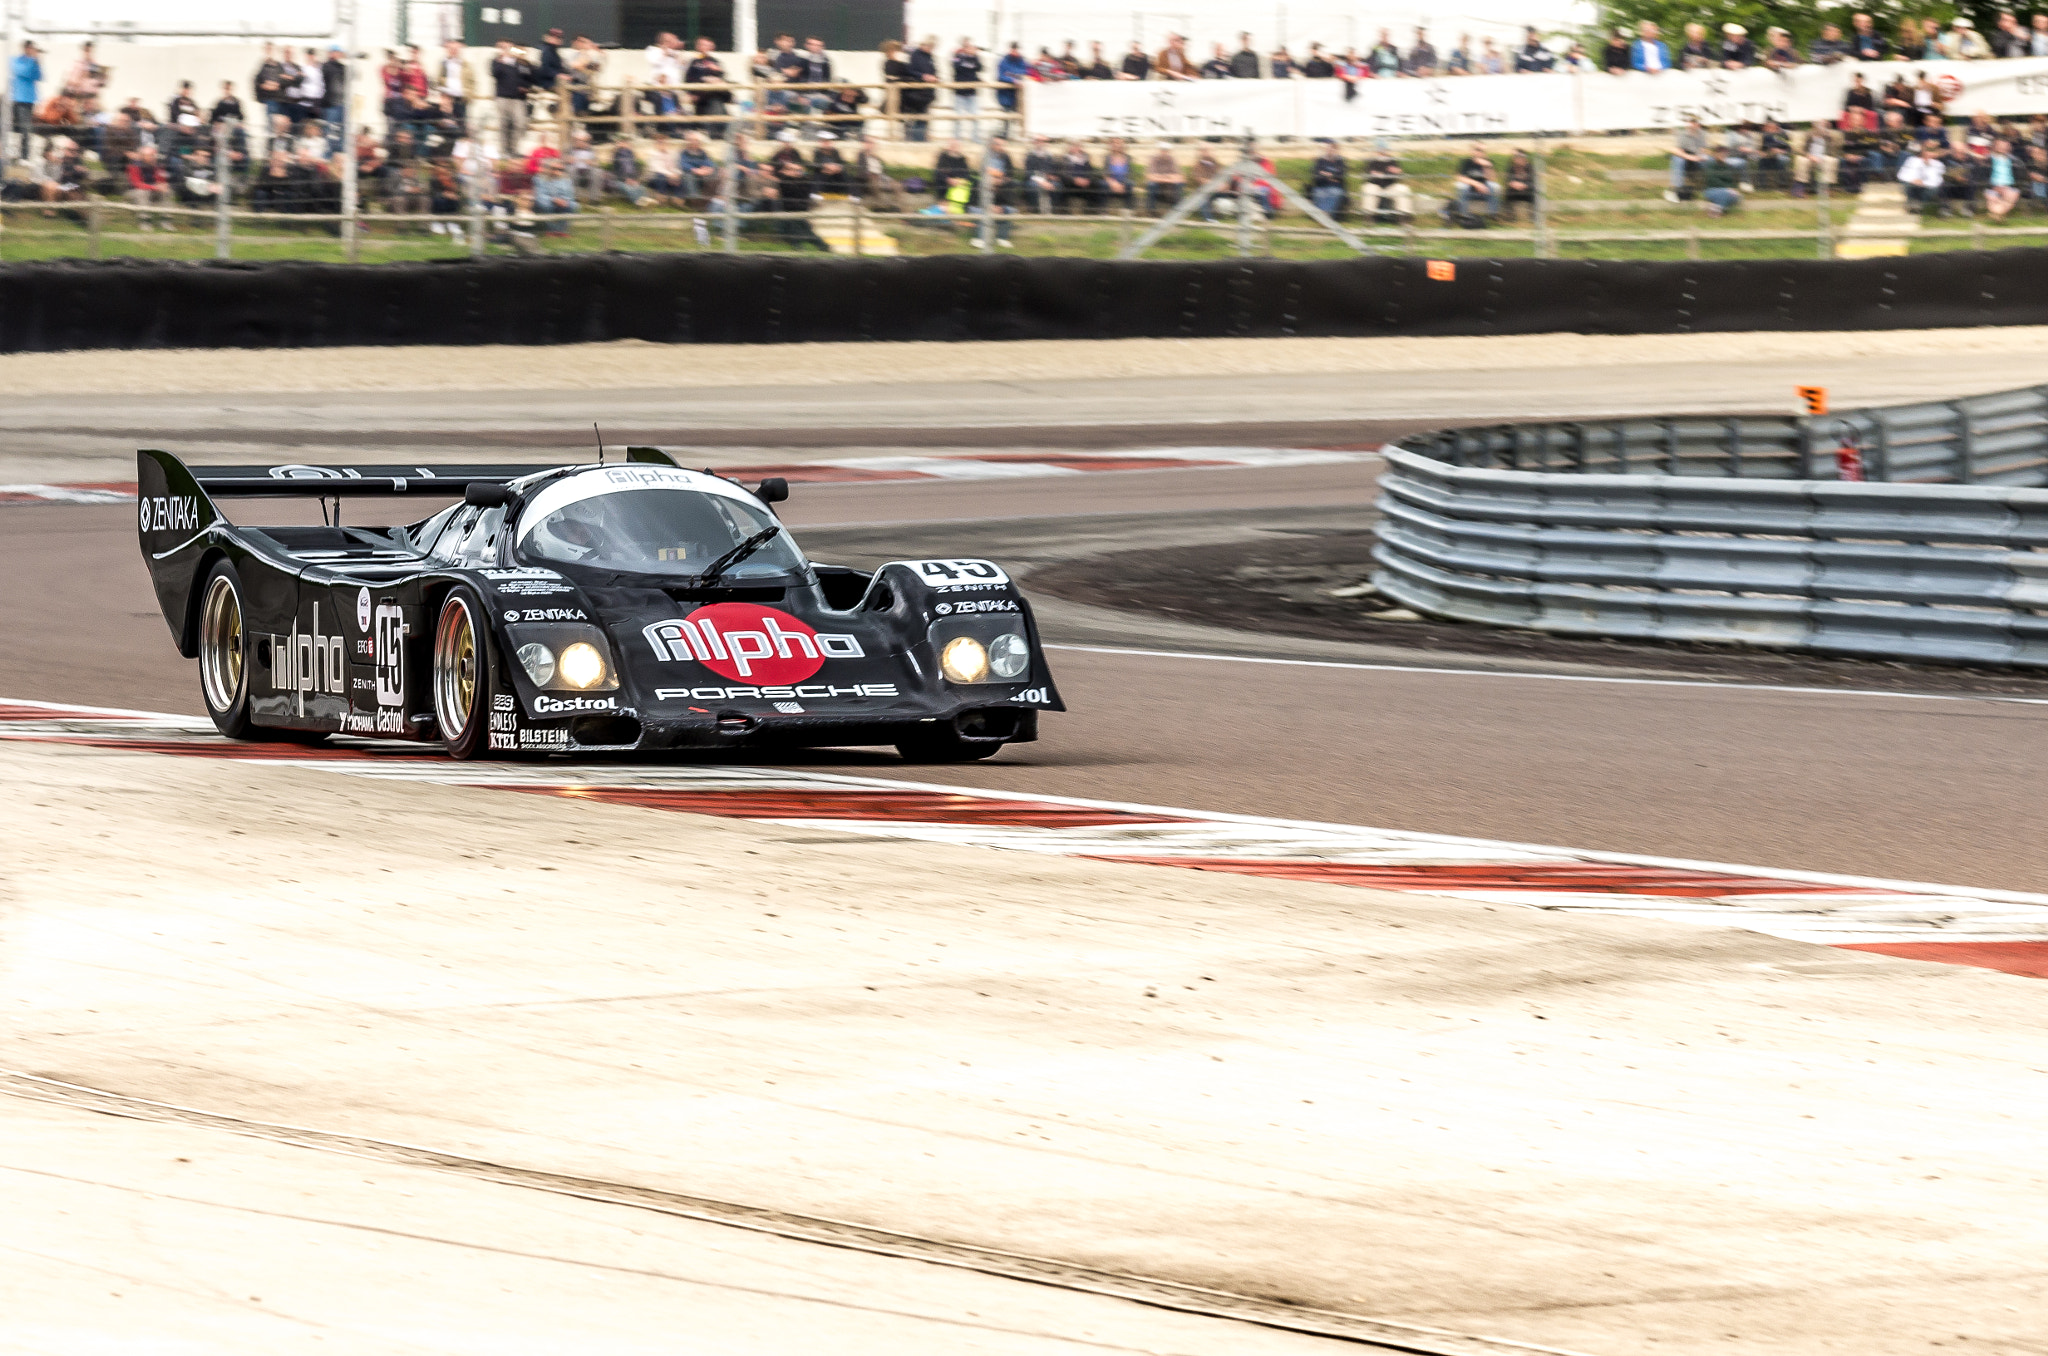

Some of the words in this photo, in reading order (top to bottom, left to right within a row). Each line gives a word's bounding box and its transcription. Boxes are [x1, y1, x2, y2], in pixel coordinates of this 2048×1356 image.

[1650, 101, 1788, 122] ZENITH
[1097, 114, 1233, 133] ZENITH
[1372, 112, 1509, 131] ZENITH
[605, 470, 693, 485] Alpha
[152, 496, 199, 531] ZENITAKA
[921, 561, 998, 579] 45
[935, 583, 1007, 593] ZENITH
[521, 608, 588, 620] ZENITAKA
[953, 600, 1019, 613] ZENITAKA
[378, 616, 401, 694] 45
[642, 617, 866, 677] Alpha
[353, 678, 376, 691] ZENITH
[654, 684, 899, 700] PORSCHE
[534, 696, 619, 713] Castrol
[347, 713, 375, 732] YOKOHAMA
[377, 706, 404, 733] Castrol
[489, 712, 517, 731] ENDLESS
[489, 733, 518, 749] KTEL
[520, 729, 568, 743] BILSTEIN
